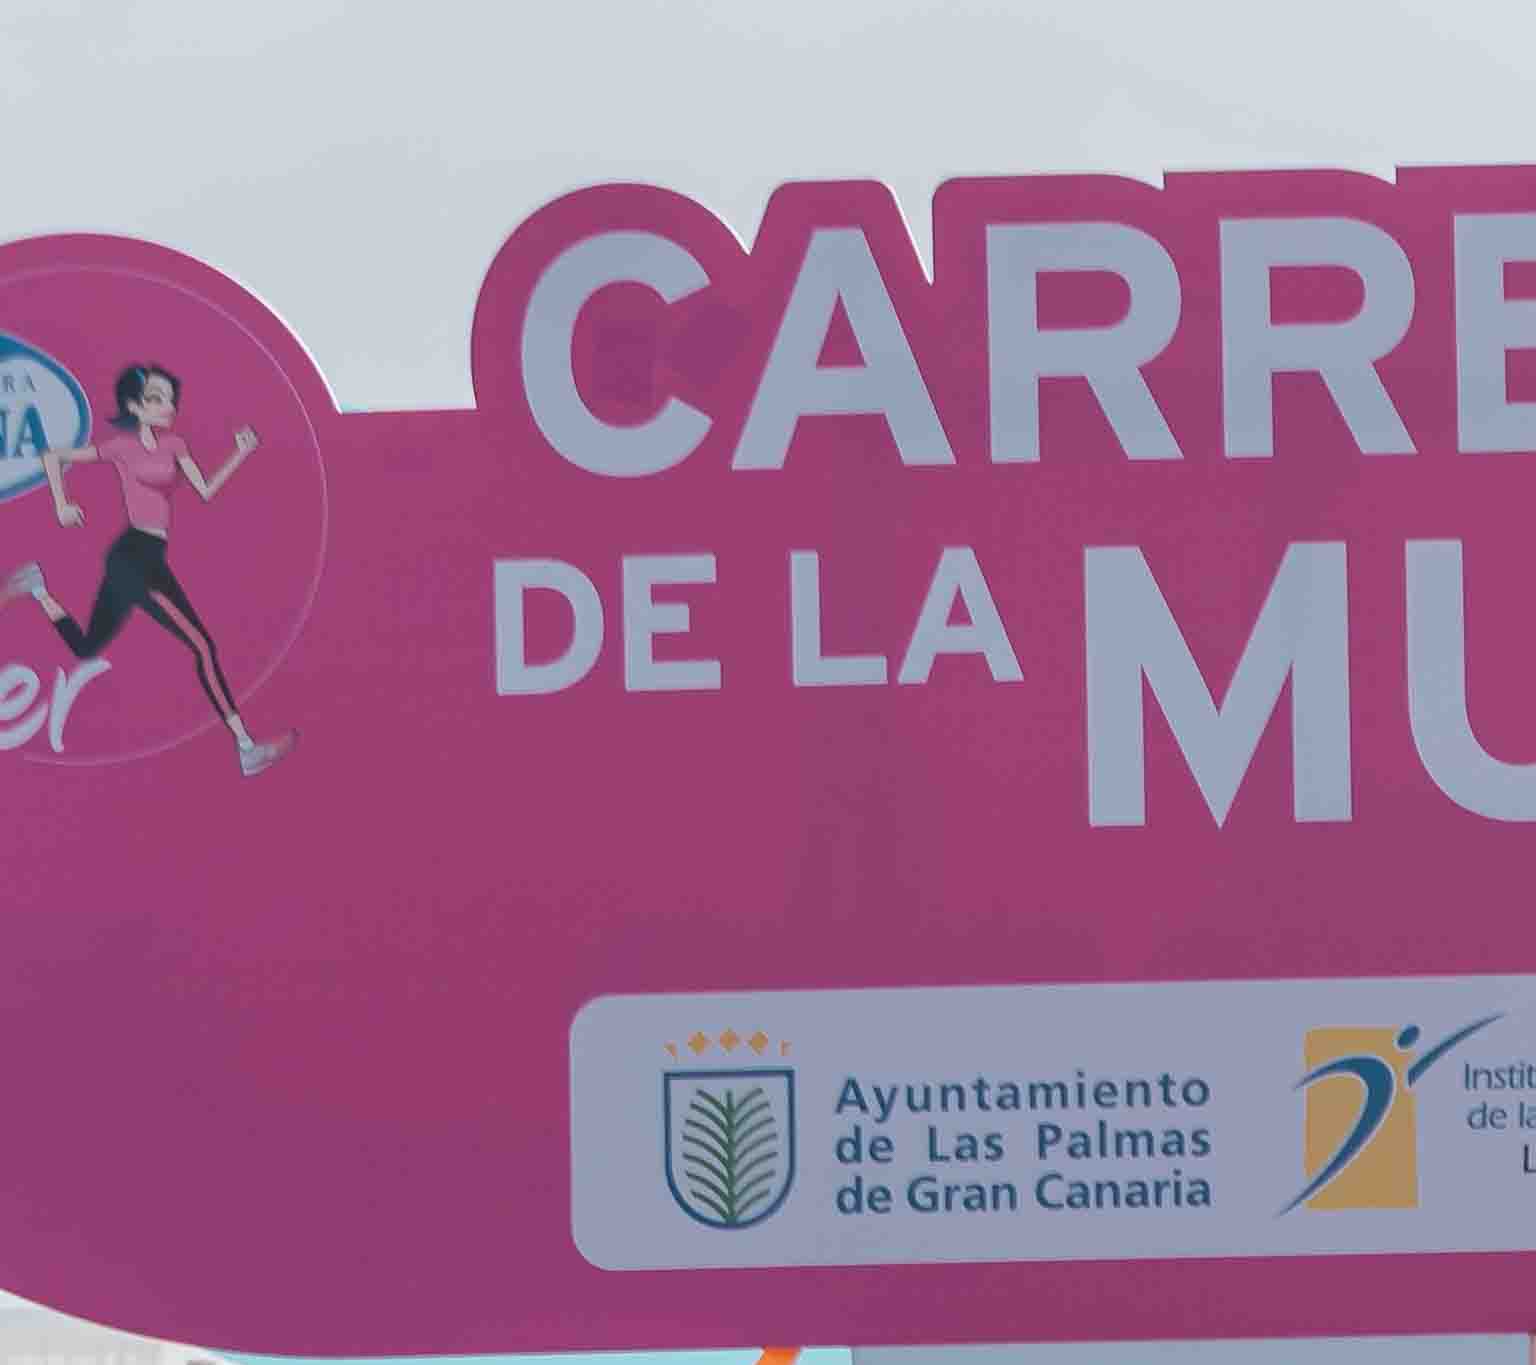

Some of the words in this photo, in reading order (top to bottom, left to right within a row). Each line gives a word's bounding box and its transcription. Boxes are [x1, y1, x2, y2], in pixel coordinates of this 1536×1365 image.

[495, 553, 726, 697] DE
[791, 546, 1024, 688] LA
[834, 1070, 1210, 1122] Ayuntamiento
[1466, 1100, 1508, 1131] de
[835, 1120, 894, 1166] de
[927, 1124, 1004, 1163] Las
[1037, 1119, 1211, 1161] Palmas
[835, 1174, 893, 1215] de
[906, 1174, 1017, 1214] Gran
[1034, 1167, 1211, 1211] Canaria
